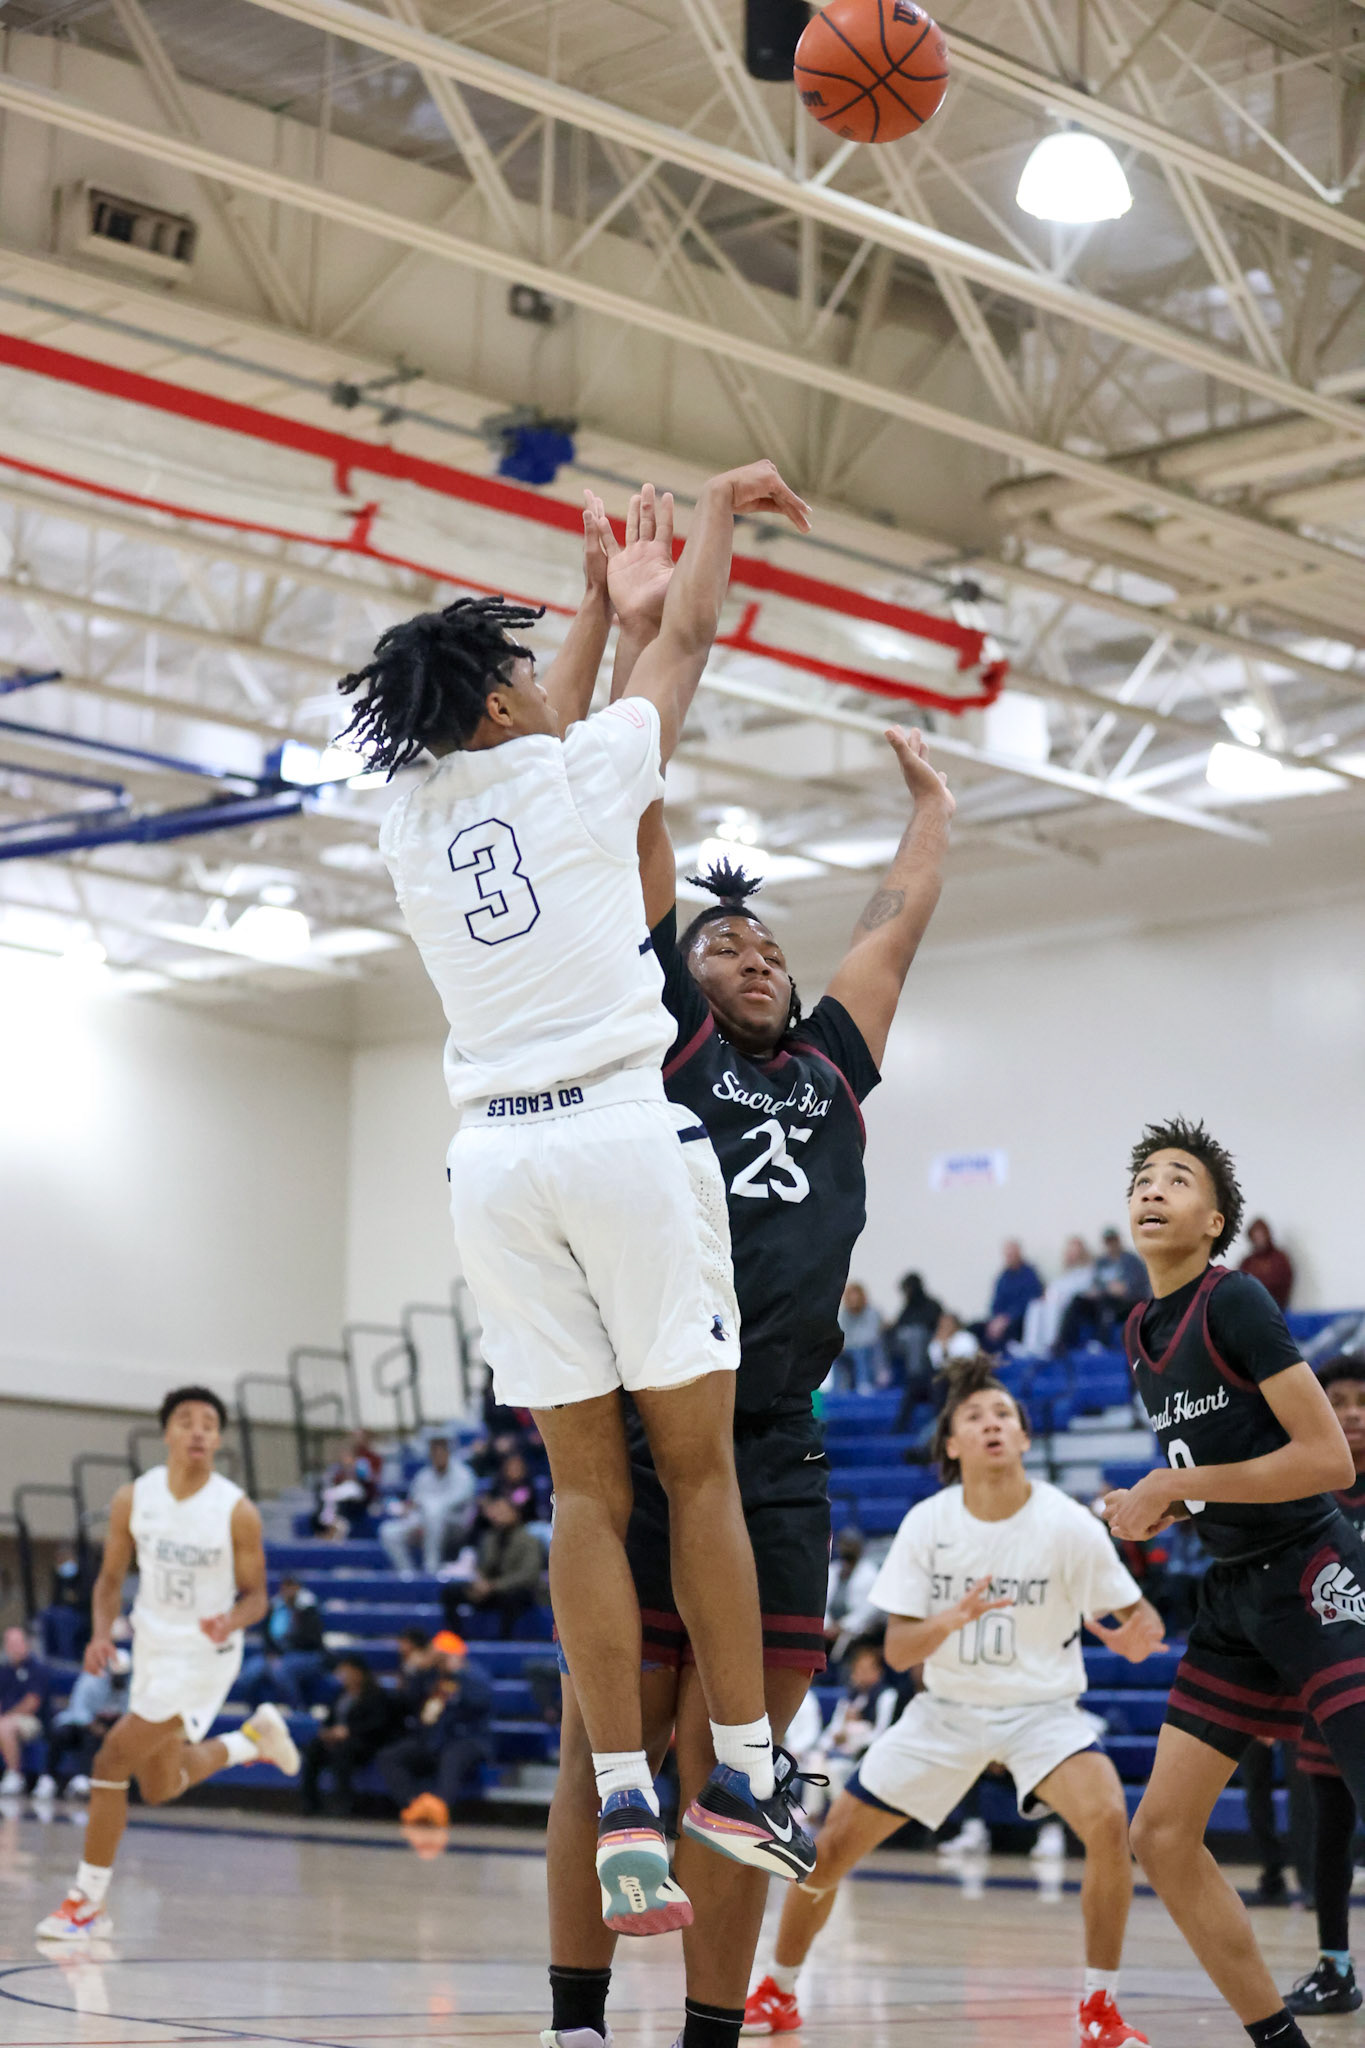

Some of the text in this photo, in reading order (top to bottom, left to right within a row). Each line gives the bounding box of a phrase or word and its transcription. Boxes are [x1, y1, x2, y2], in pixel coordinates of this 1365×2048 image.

[447, 817, 541, 946] 3
[487, 1086, 584, 1117] GO EAGLES
[729, 1118, 814, 1204] 25
[1173, 1385, 1229, 1424] Heart
[964, 1577, 1049, 1607] BNEDICT
[959, 1611, 1017, 1667] 10
